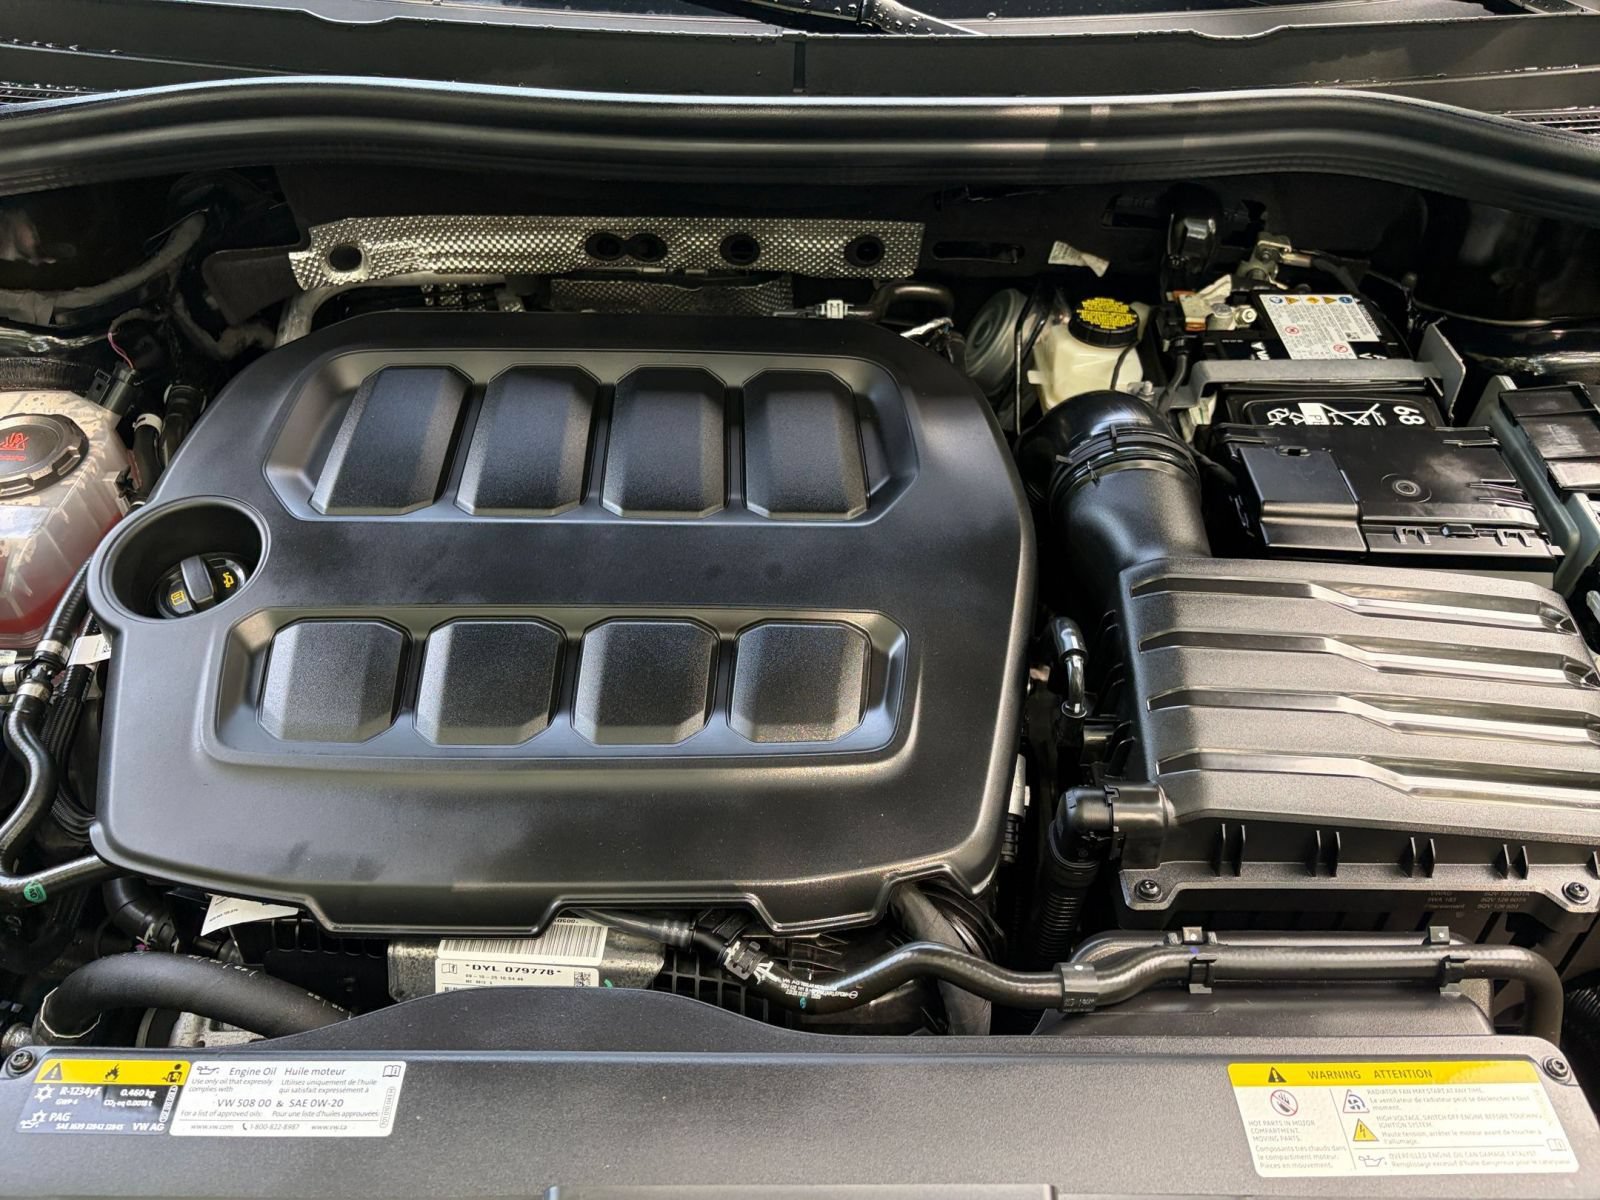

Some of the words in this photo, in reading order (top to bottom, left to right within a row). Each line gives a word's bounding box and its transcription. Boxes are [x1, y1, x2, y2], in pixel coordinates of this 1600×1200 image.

[229, 1067, 261, 1078] Engine
[263, 1067, 277, 1076] Oil
[284, 1067, 310, 1076] Huile
[311, 1068, 346, 1076] moteur
[1308, 1070, 1361, 1080] WARNING
[1374, 1069, 1433, 1079] ATTENTION
[59, 1086, 102, 1098] R-1234yf
[145, 1088, 157, 1099] kg
[217, 1099, 236, 1107] VW
[236, 1099, 256, 1107] 508
[257, 1099, 272, 1107] 00
[288, 1099, 309, 1107] SAE
[310, 1099, 344, 1107] 0W-20
[49, 1112, 71, 1122] PAG
[218, 1110, 248, 1118] approved
[132, 1123, 149, 1131] VW
[149, 1123, 165, 1131] AG
